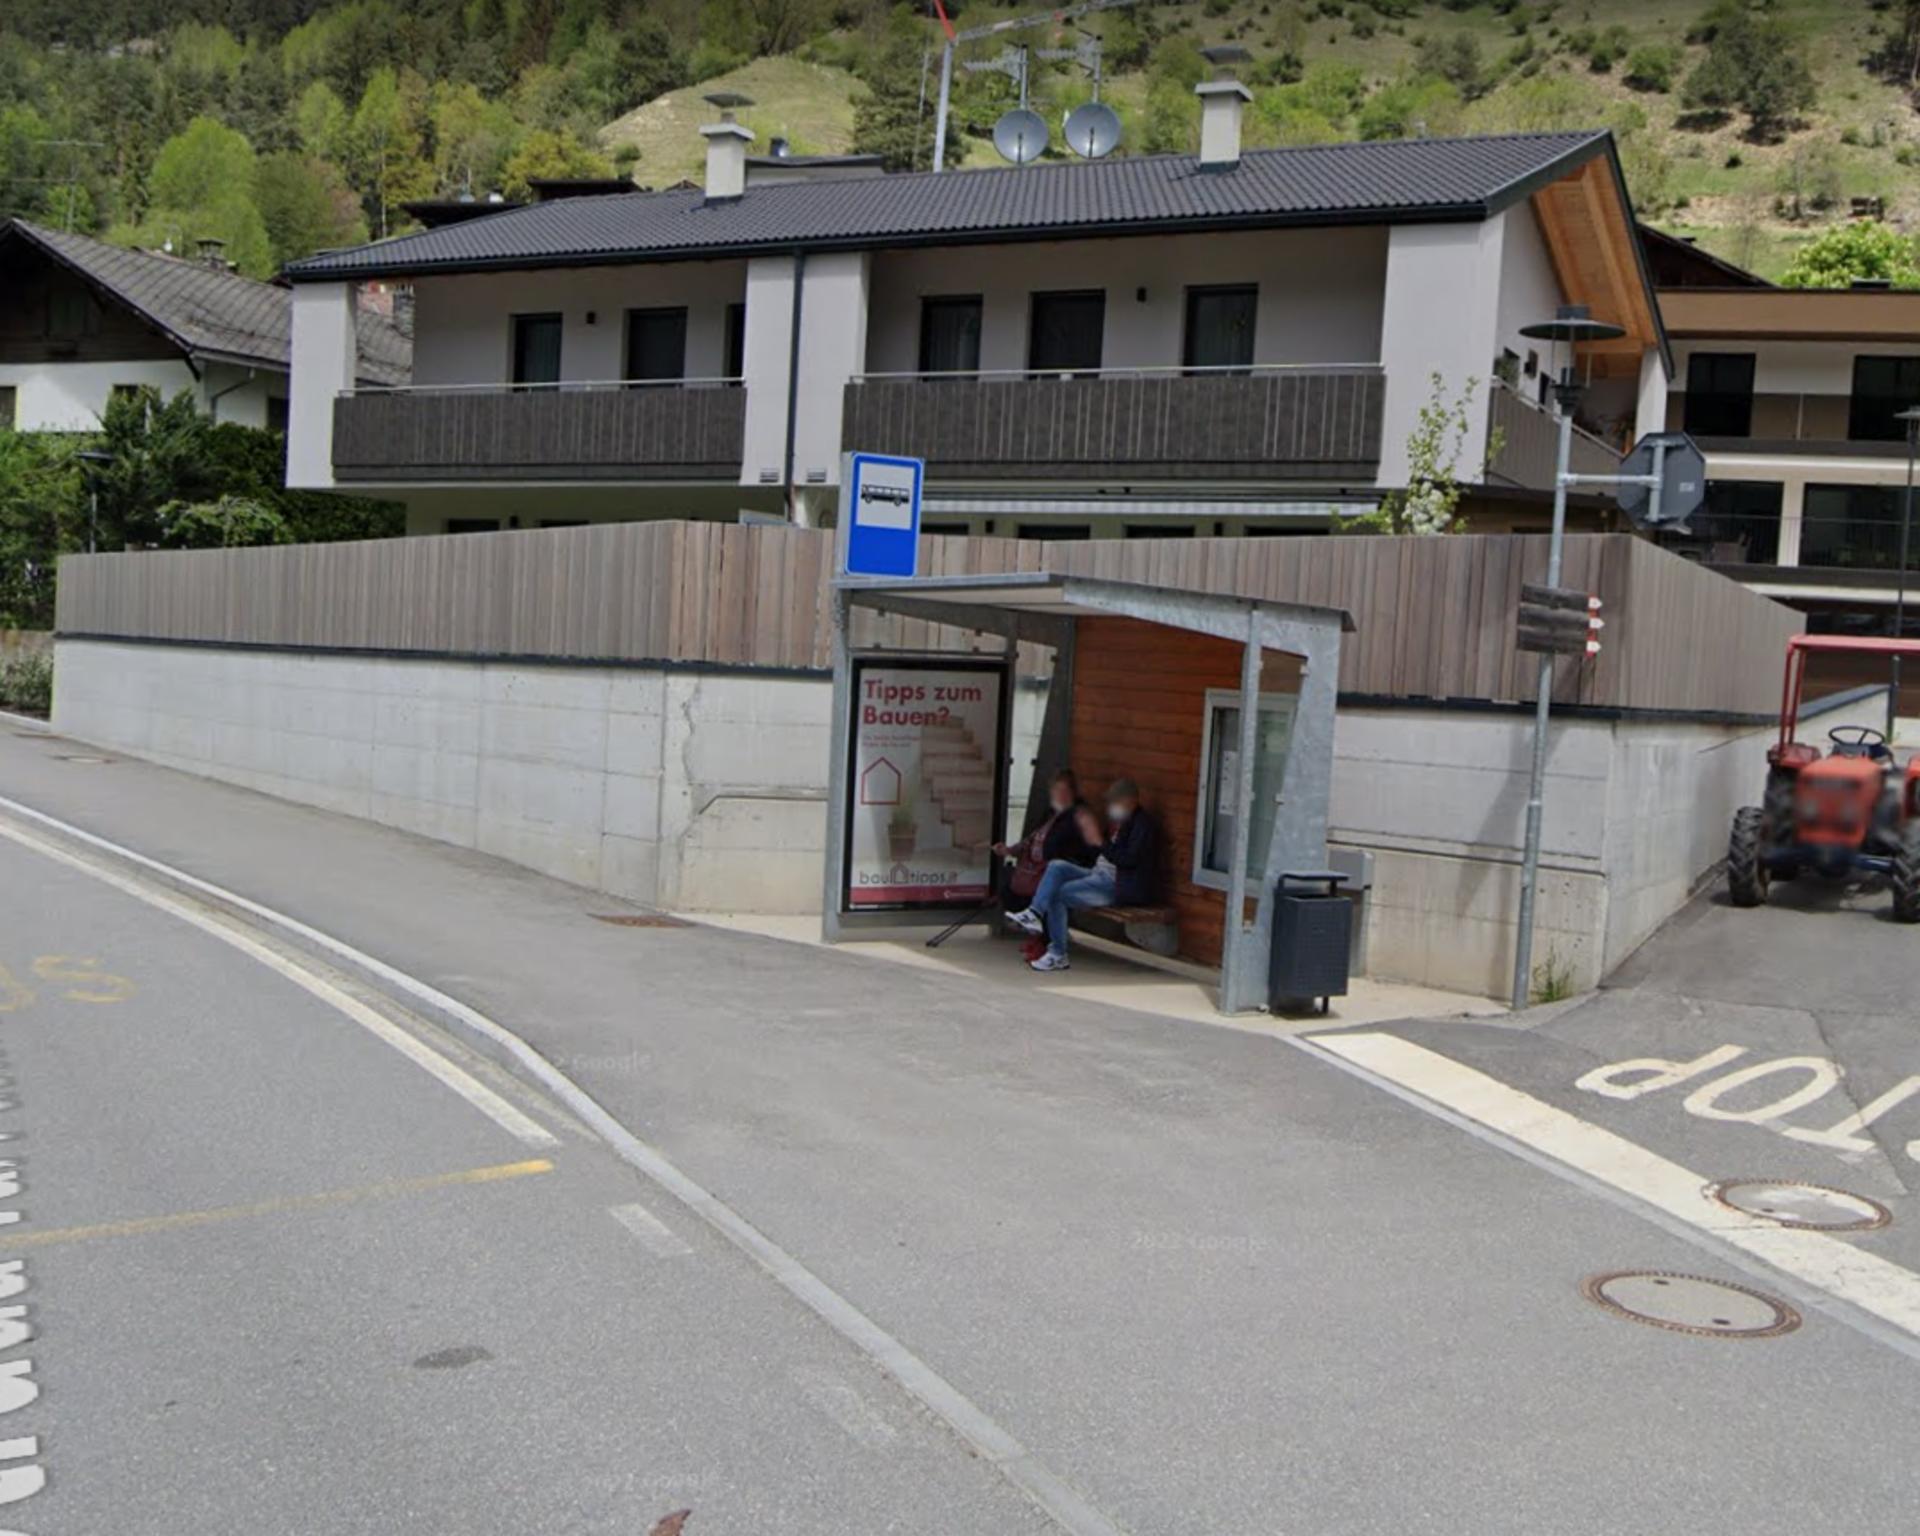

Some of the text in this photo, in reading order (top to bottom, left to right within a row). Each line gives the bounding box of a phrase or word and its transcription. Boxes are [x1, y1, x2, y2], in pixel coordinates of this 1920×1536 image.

[864, 679, 981, 706] Tipps zum
[863, 705, 950, 727] Bauen?
[1574, 1043, 1920, 1163] TOP
